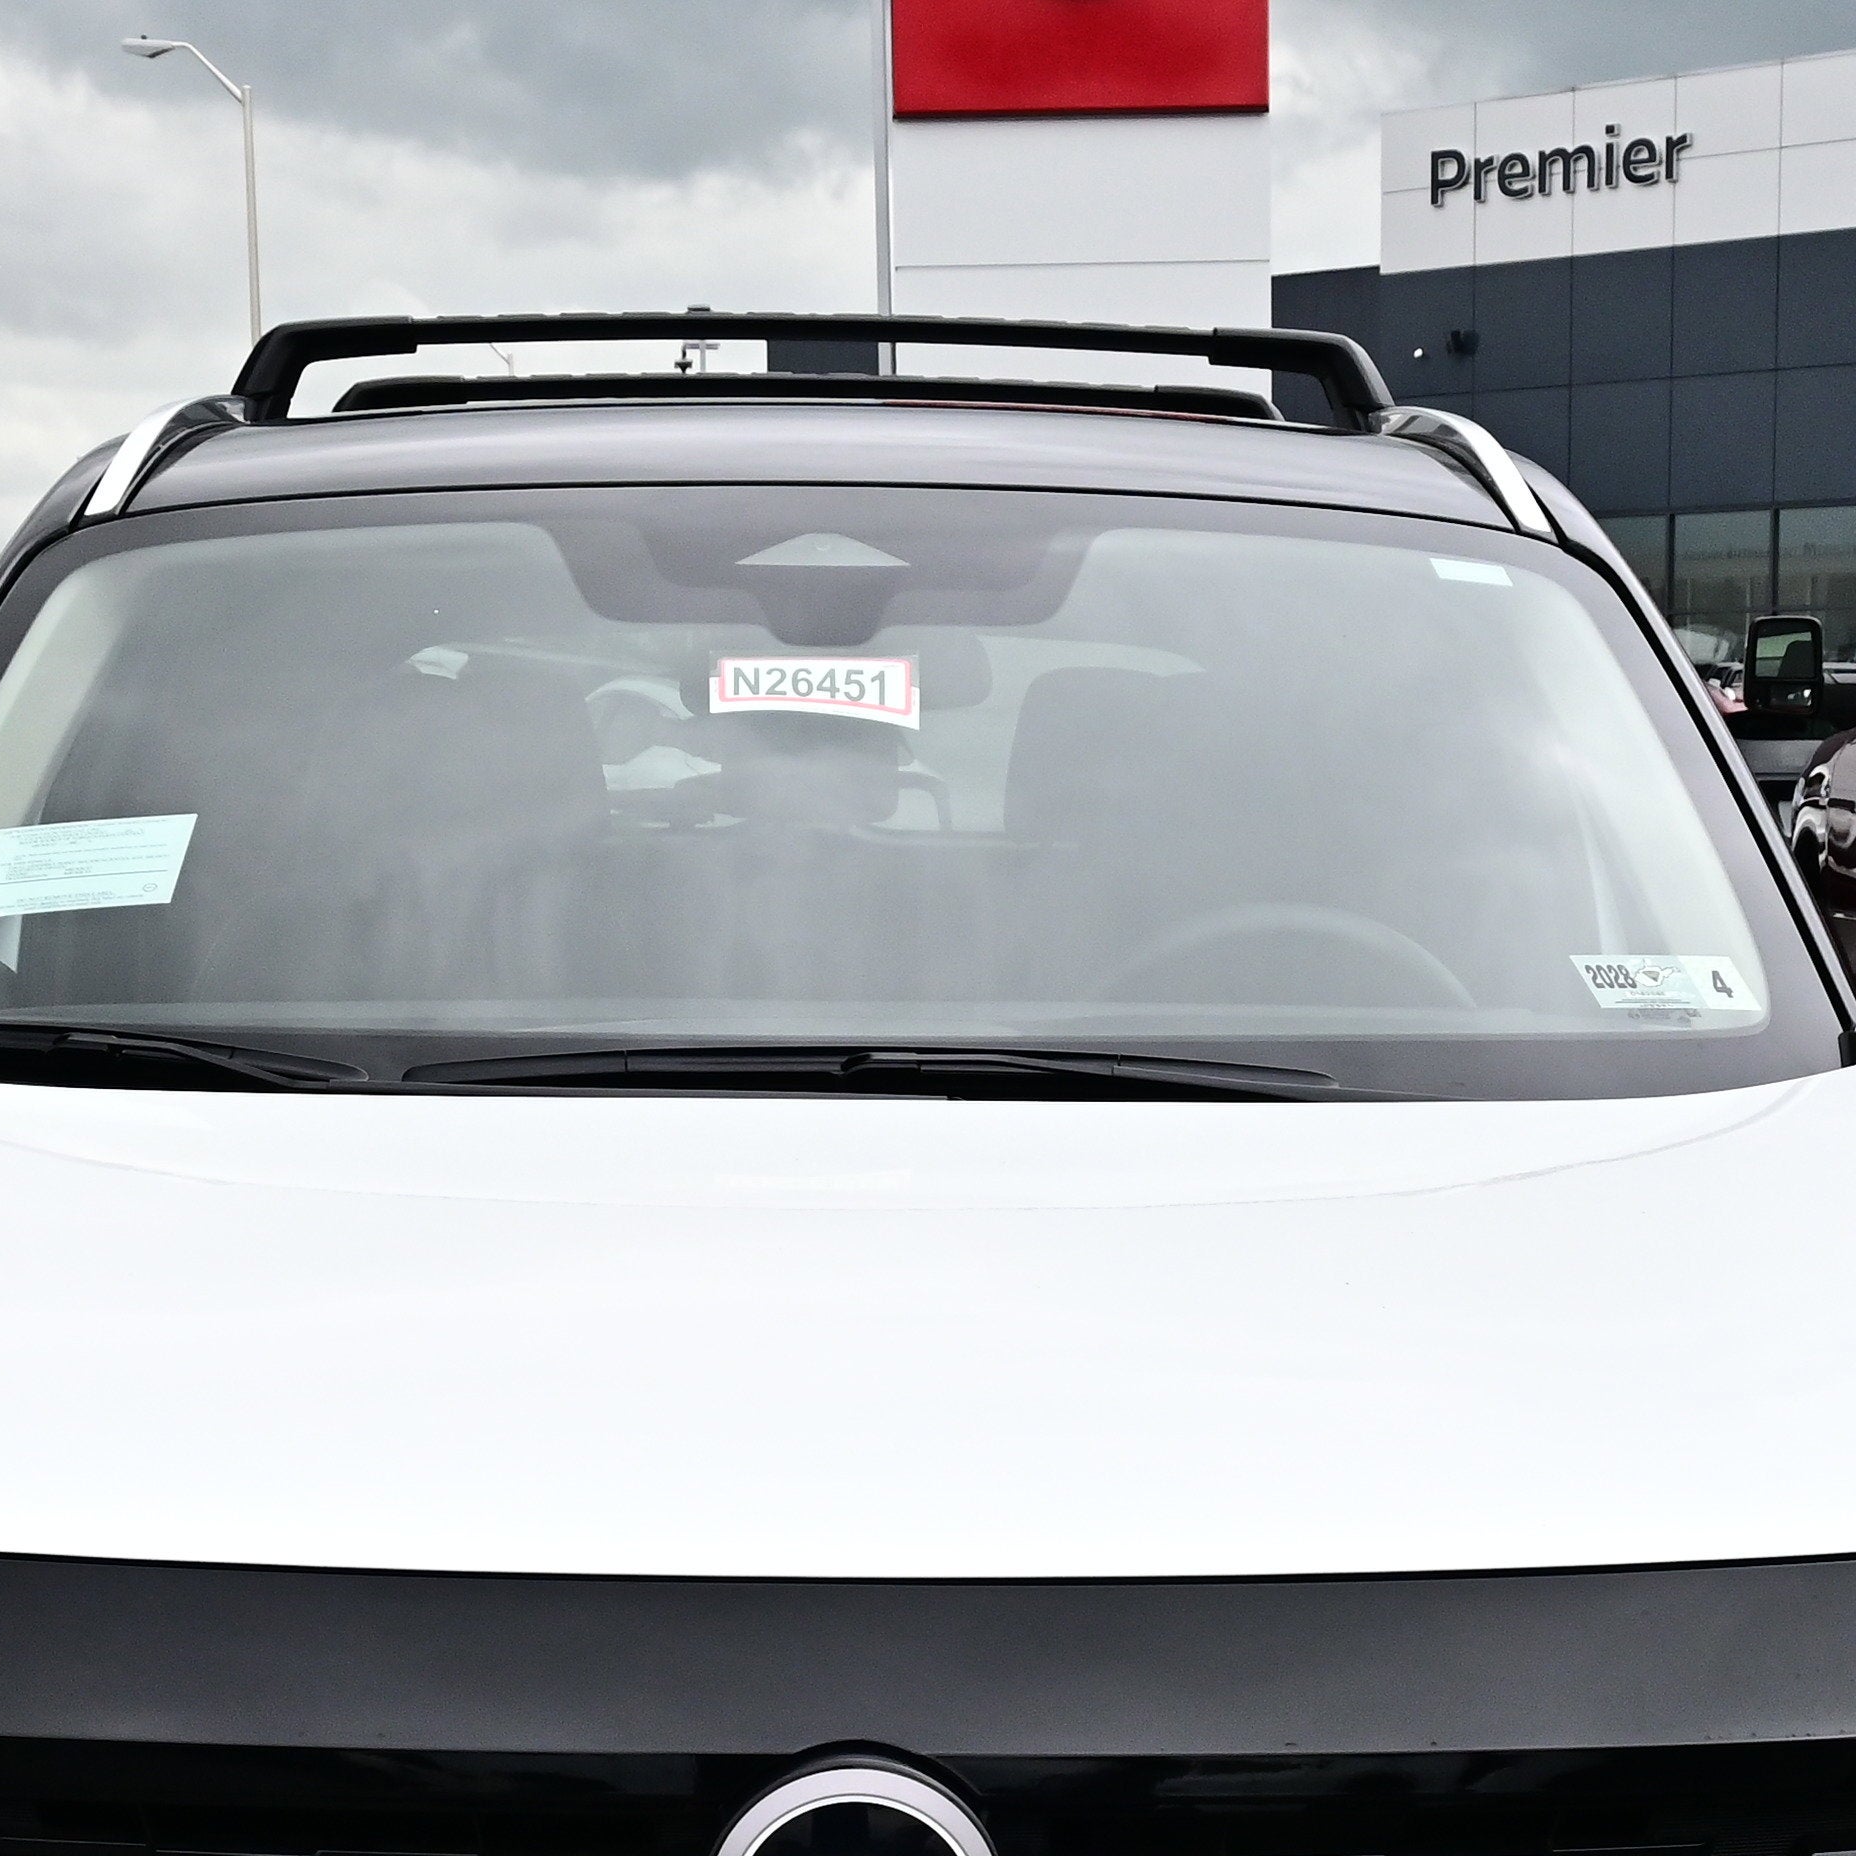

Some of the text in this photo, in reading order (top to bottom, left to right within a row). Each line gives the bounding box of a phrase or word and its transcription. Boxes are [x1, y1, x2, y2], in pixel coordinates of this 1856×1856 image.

[1430, 124, 1692, 207] Premier
[733, 667, 886, 706] N26451
[1585, 964, 1637, 989] 2028
[1712, 970, 1734, 998] 4
